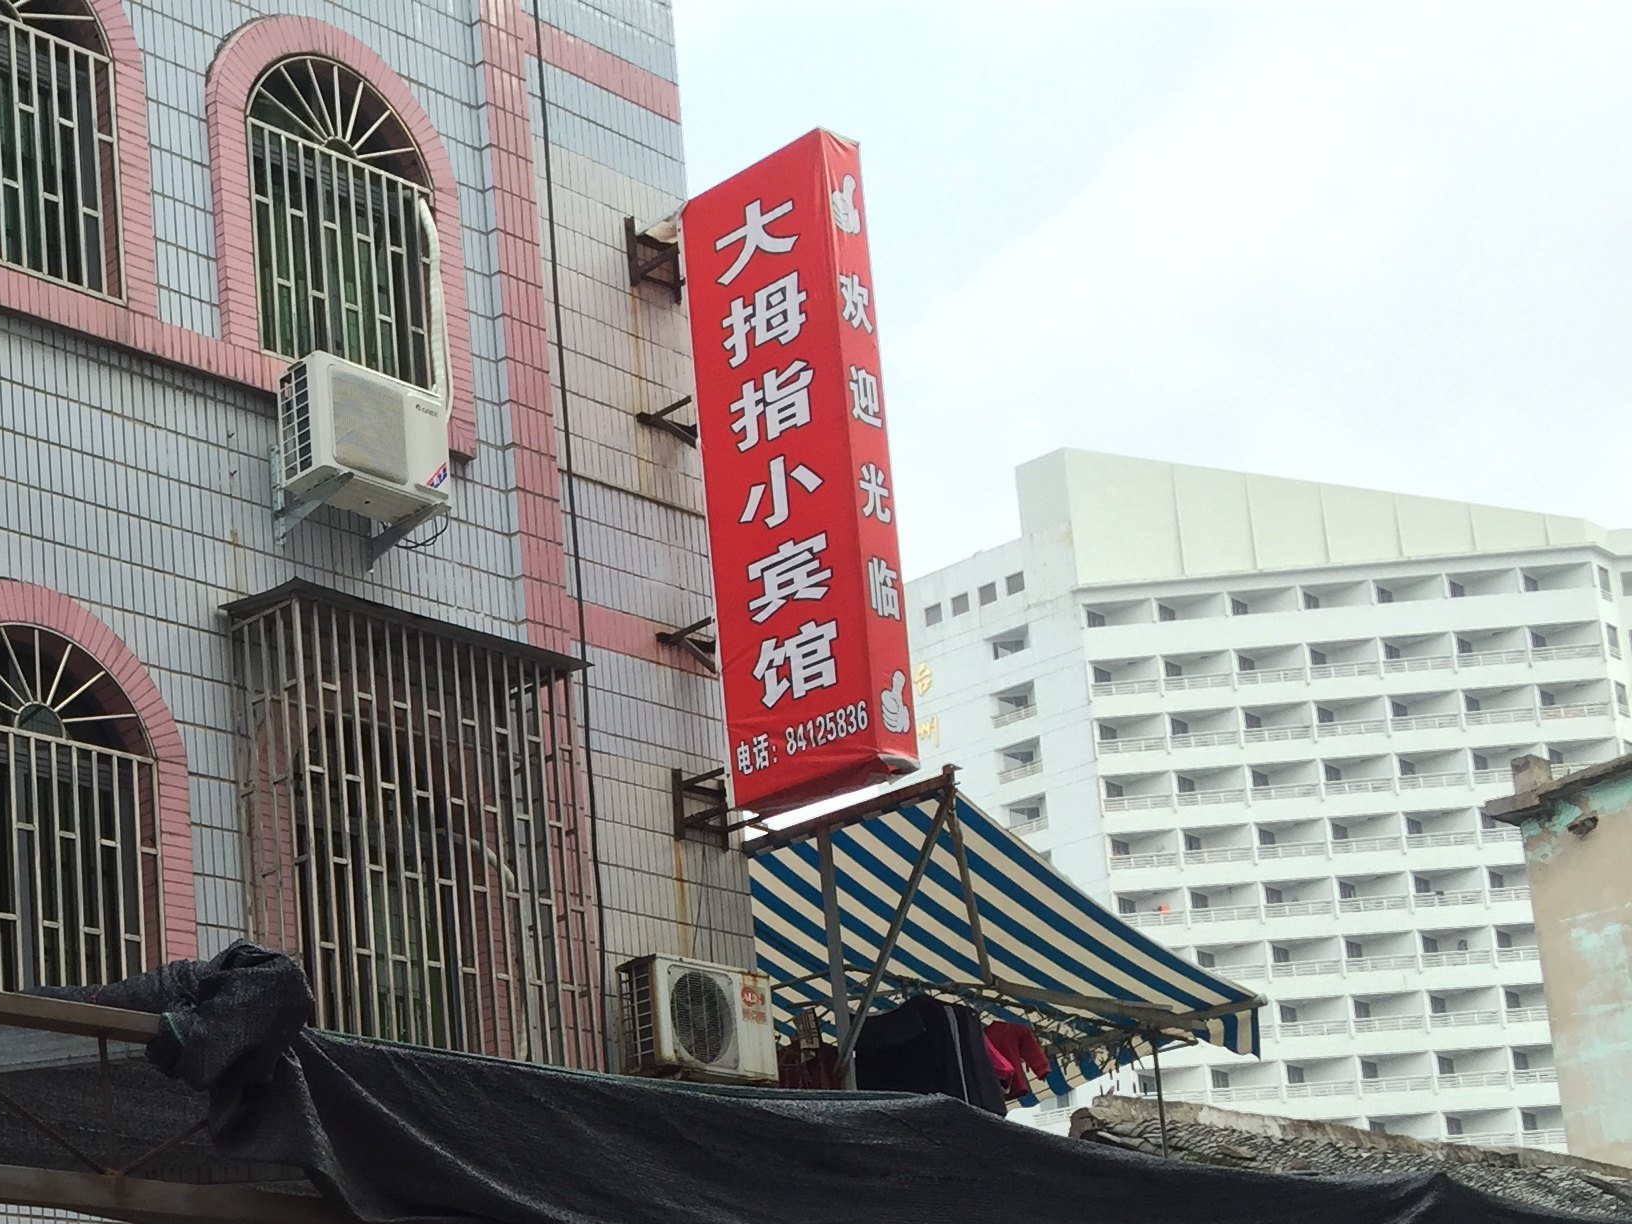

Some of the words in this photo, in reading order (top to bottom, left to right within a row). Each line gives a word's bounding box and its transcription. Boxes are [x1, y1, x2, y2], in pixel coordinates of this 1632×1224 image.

[714, 197, 839, 711] 大拇指小宾馆
[838, 272, 902, 624] 欢迎光临
[735, 700, 870, 777] 电话：84125836
